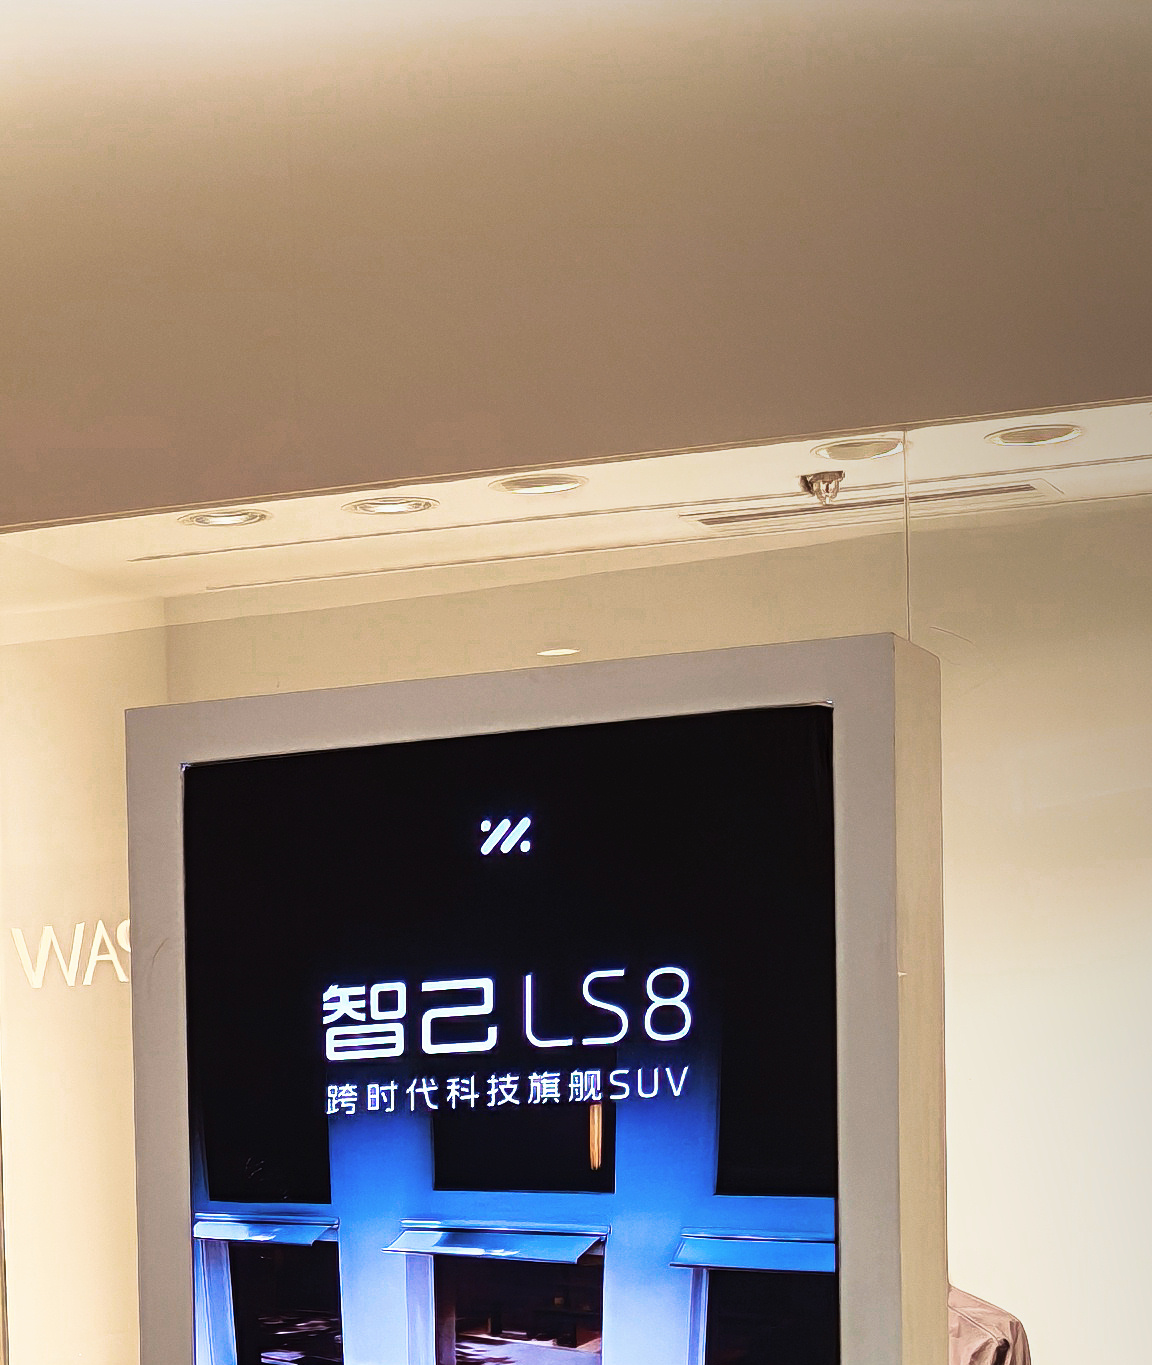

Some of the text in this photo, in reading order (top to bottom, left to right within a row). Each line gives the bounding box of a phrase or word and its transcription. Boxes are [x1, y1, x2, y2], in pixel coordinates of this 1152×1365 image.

[325, 1066, 690, 1115] 跨时代科技旗舰SUV
